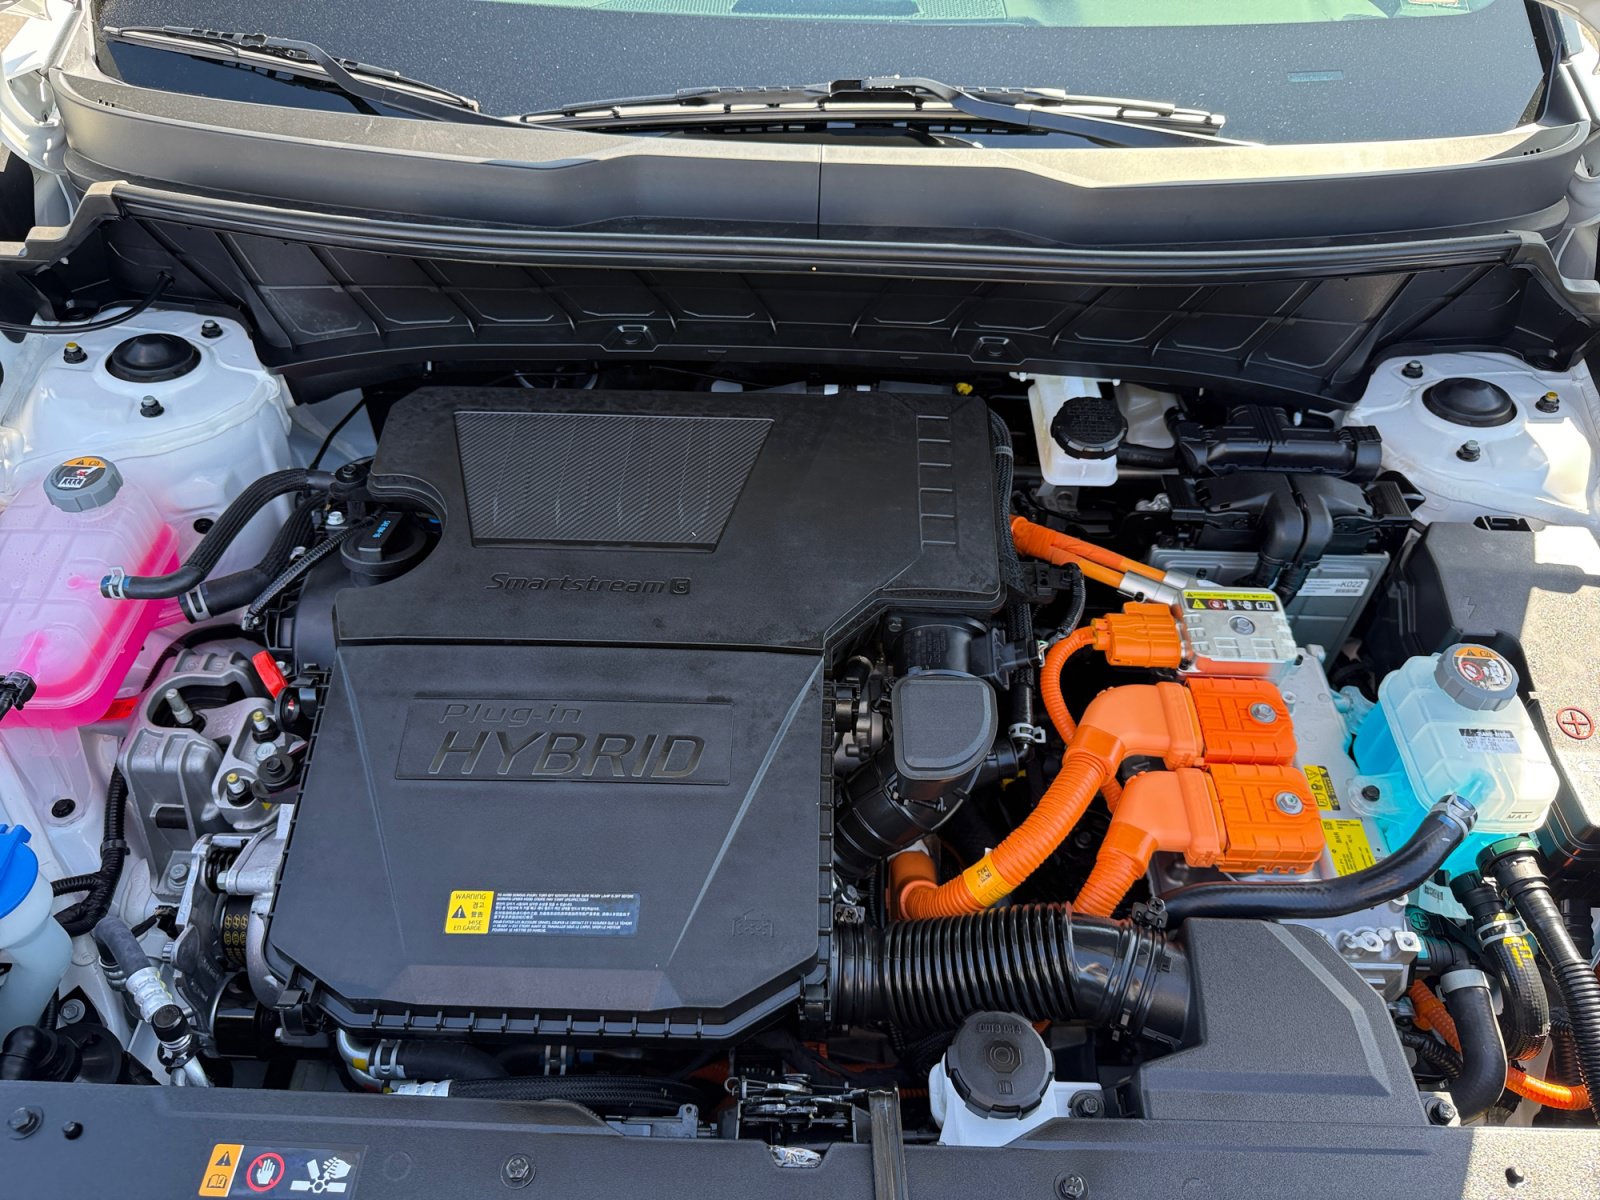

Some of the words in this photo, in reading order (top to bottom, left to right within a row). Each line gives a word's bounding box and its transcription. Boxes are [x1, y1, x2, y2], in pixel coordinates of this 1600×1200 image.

[485, 572, 665, 594] Smartstream
[669, 577, 691, 595] G
[438, 703, 583, 728] Plug-in
[428, 731, 706, 778] HYBRID
